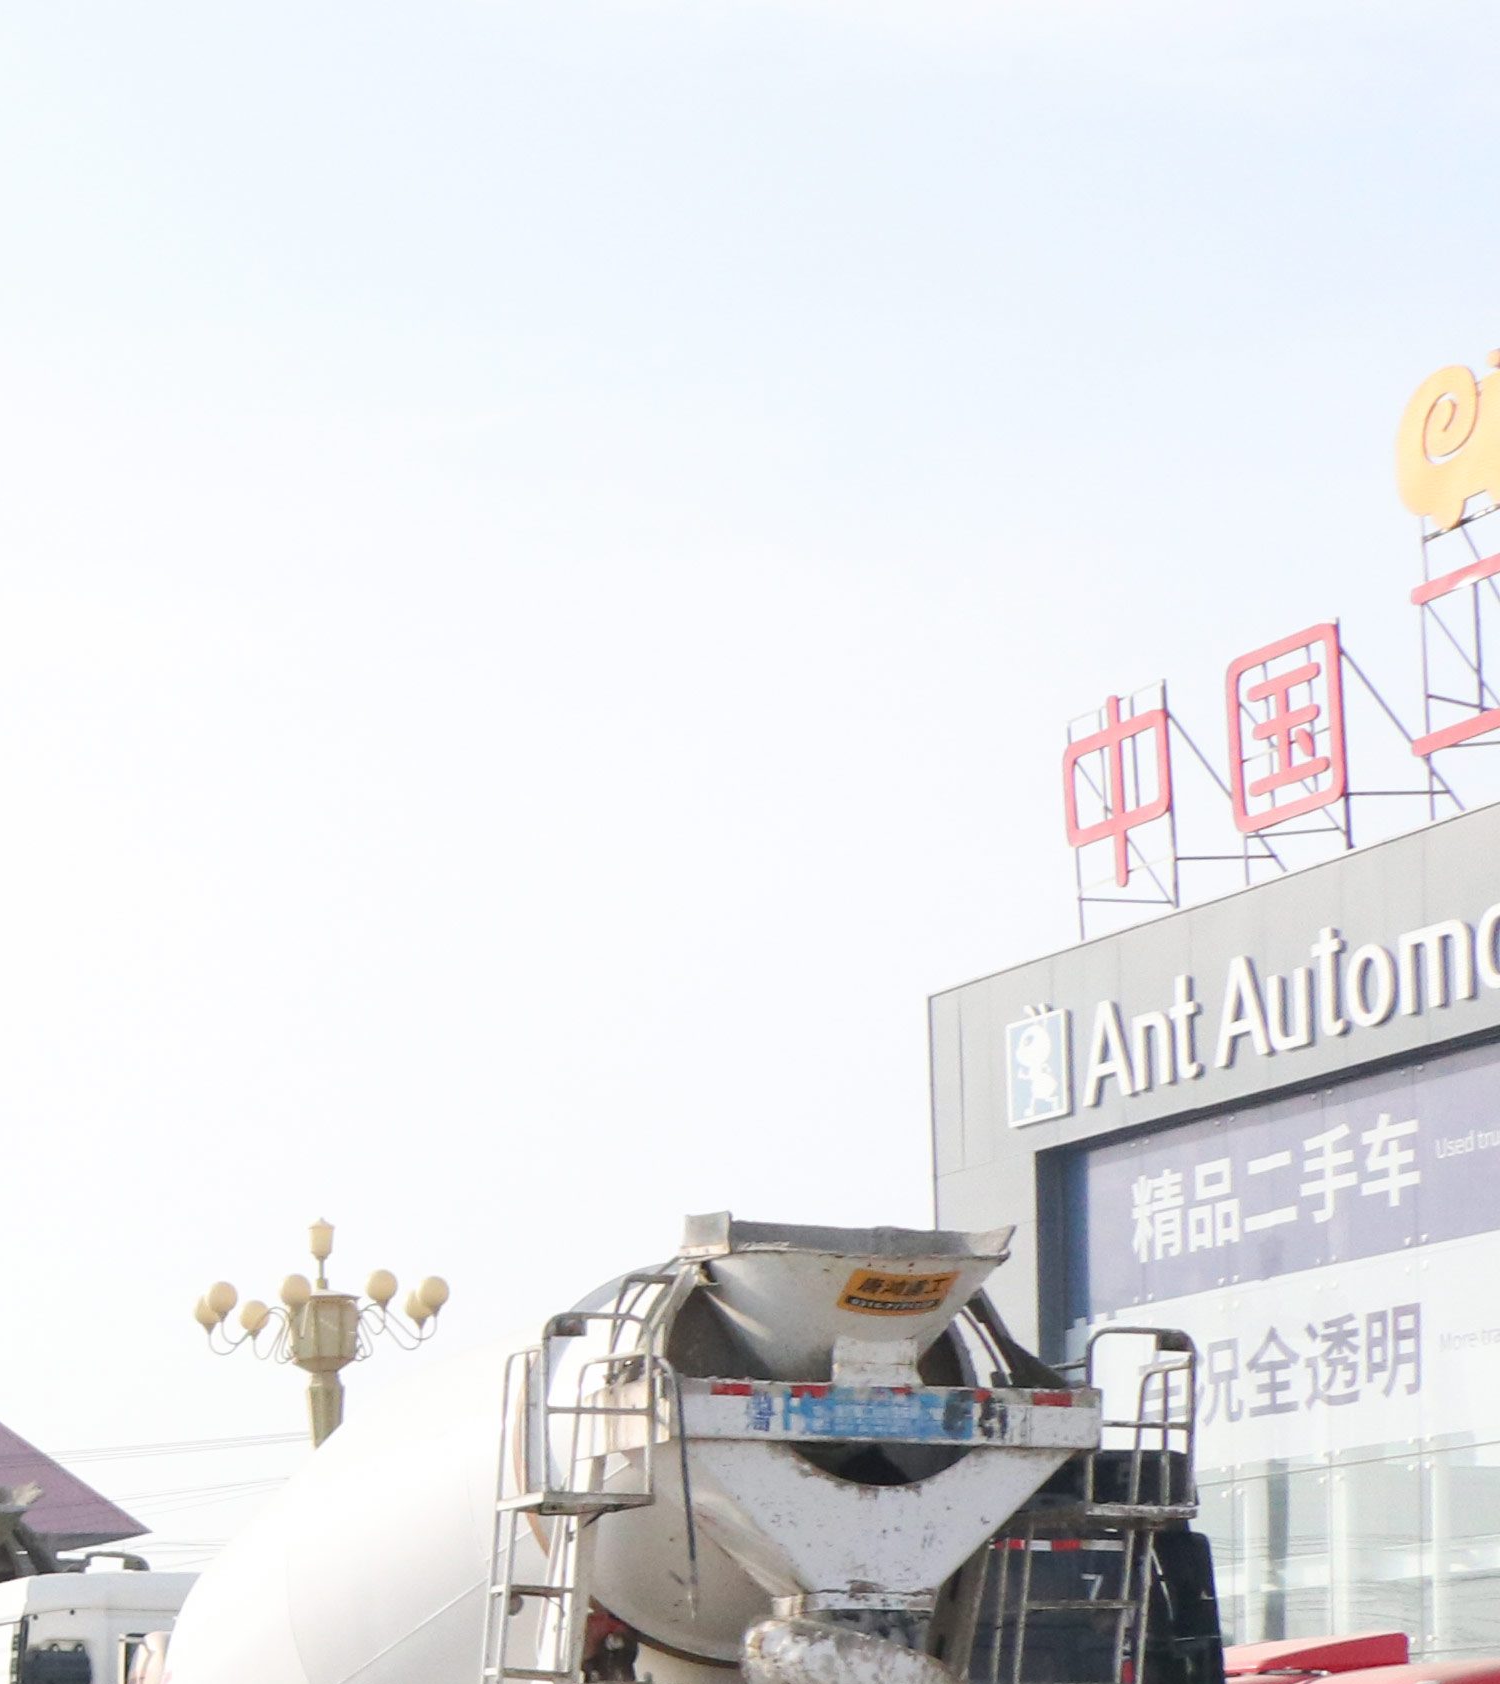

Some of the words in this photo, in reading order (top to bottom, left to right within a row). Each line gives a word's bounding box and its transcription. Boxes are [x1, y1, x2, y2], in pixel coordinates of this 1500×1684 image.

[1083, 975, 1205, 1107] Ant
[1132, 1112, 1422, 1263] 精品二手车
[1436, 1131, 1474, 1159] Used
